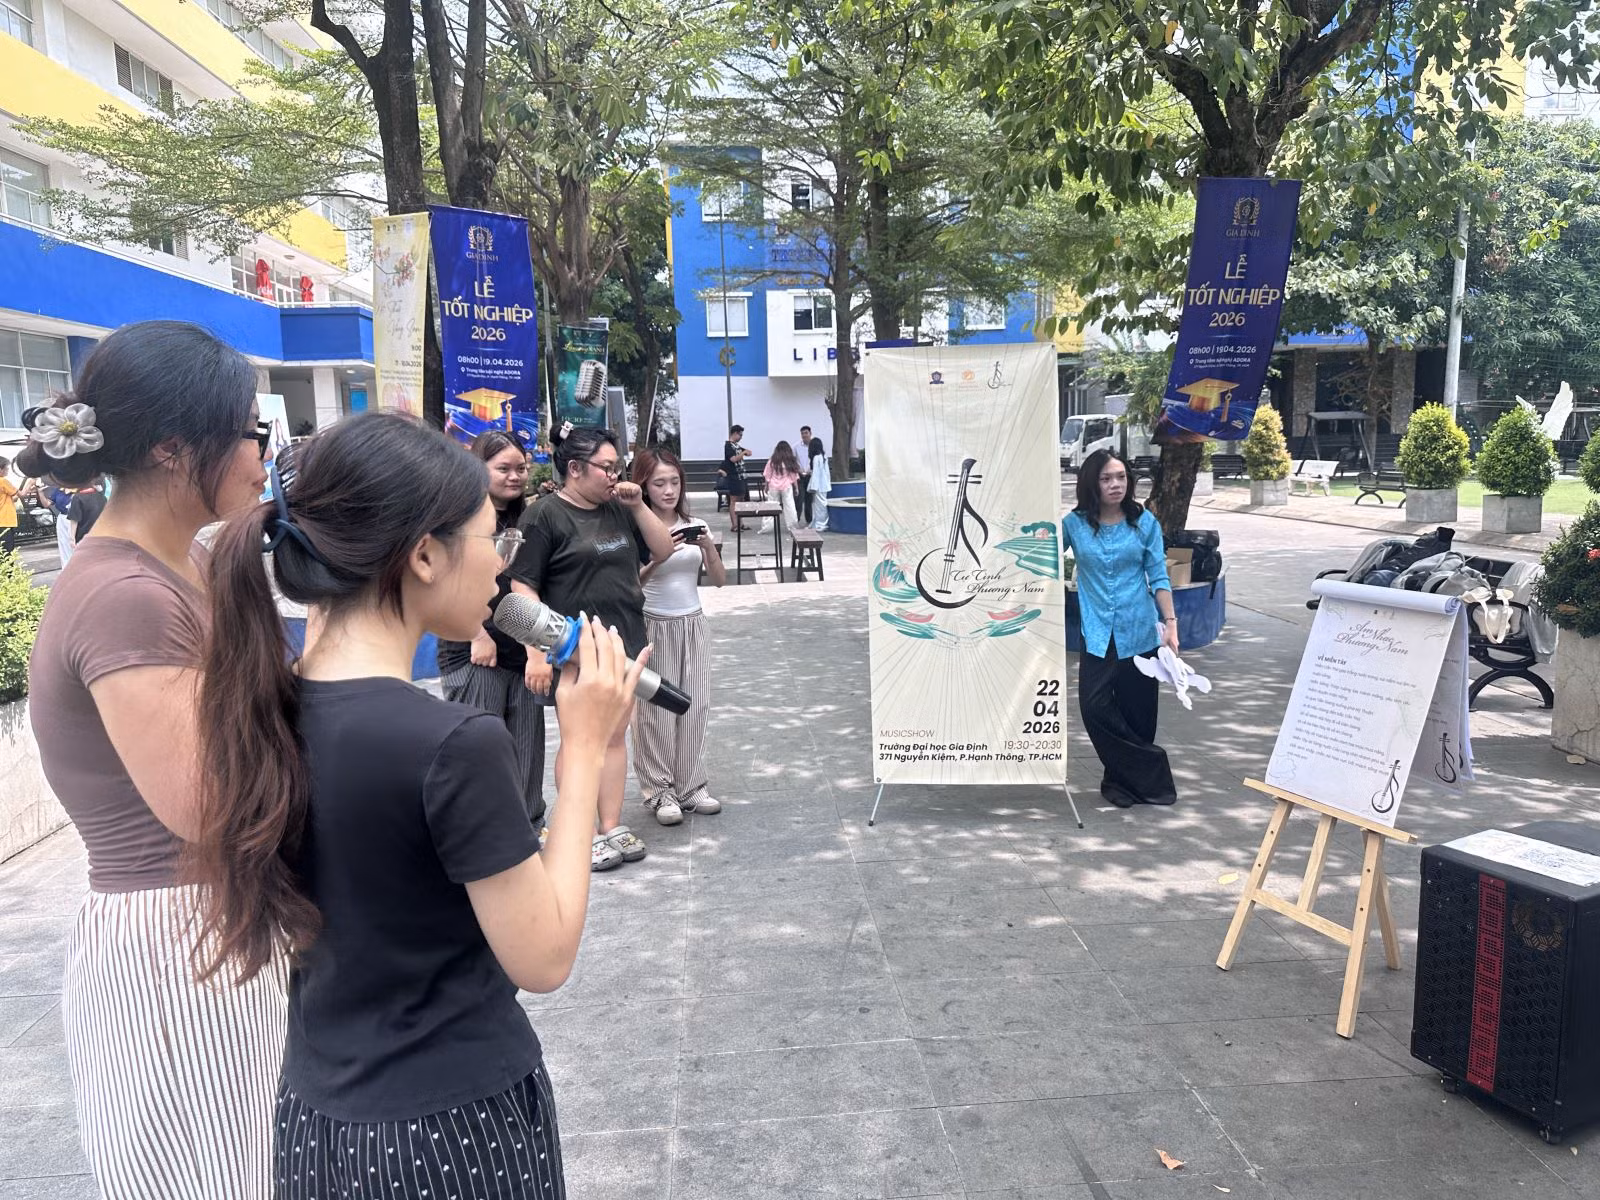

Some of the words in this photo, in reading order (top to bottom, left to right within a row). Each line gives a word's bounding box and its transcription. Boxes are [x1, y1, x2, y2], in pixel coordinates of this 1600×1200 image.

[1224, 254, 1248, 279] LỄ
[474, 275, 495, 298] LỄ
[1187, 281, 1217, 306] TỐT
[1217, 284, 1280, 309] NGHIỆP
[441, 295, 470, 318] TỐT
[473, 303, 533, 326] NGHIỆP
[1208, 311, 1246, 327] 2026
[471, 325, 506, 341] 2026
[1188, 346, 1211, 355] 08h00
[457, 355, 480, 364] 08h00
[483, 358, 524, 367] 19.04.2026
[1012, 581, 1044, 593] Nam
[1037, 680, 1059, 696] 22
[1033, 700, 1059, 717] 04
[880, 729, 935, 738] MUSICSHOW
[1022, 721, 1060, 734] 2026
[879, 743, 911, 753] Trường
[912, 743, 928, 753] Đại
[929, 743, 947, 752] học
[948, 743, 965, 751] Gia
[966, 743, 988, 752] Định
[1004, 740, 1062, 750] 19:30-20:30
[879, 753, 892, 761] 371
[931, 752, 958, 762] Kiệm,
[960, 753, 993, 762] P.Hạnh
[995, 752, 1026, 763] Thông,
[1029, 753, 1062, 761] TP.HCM
